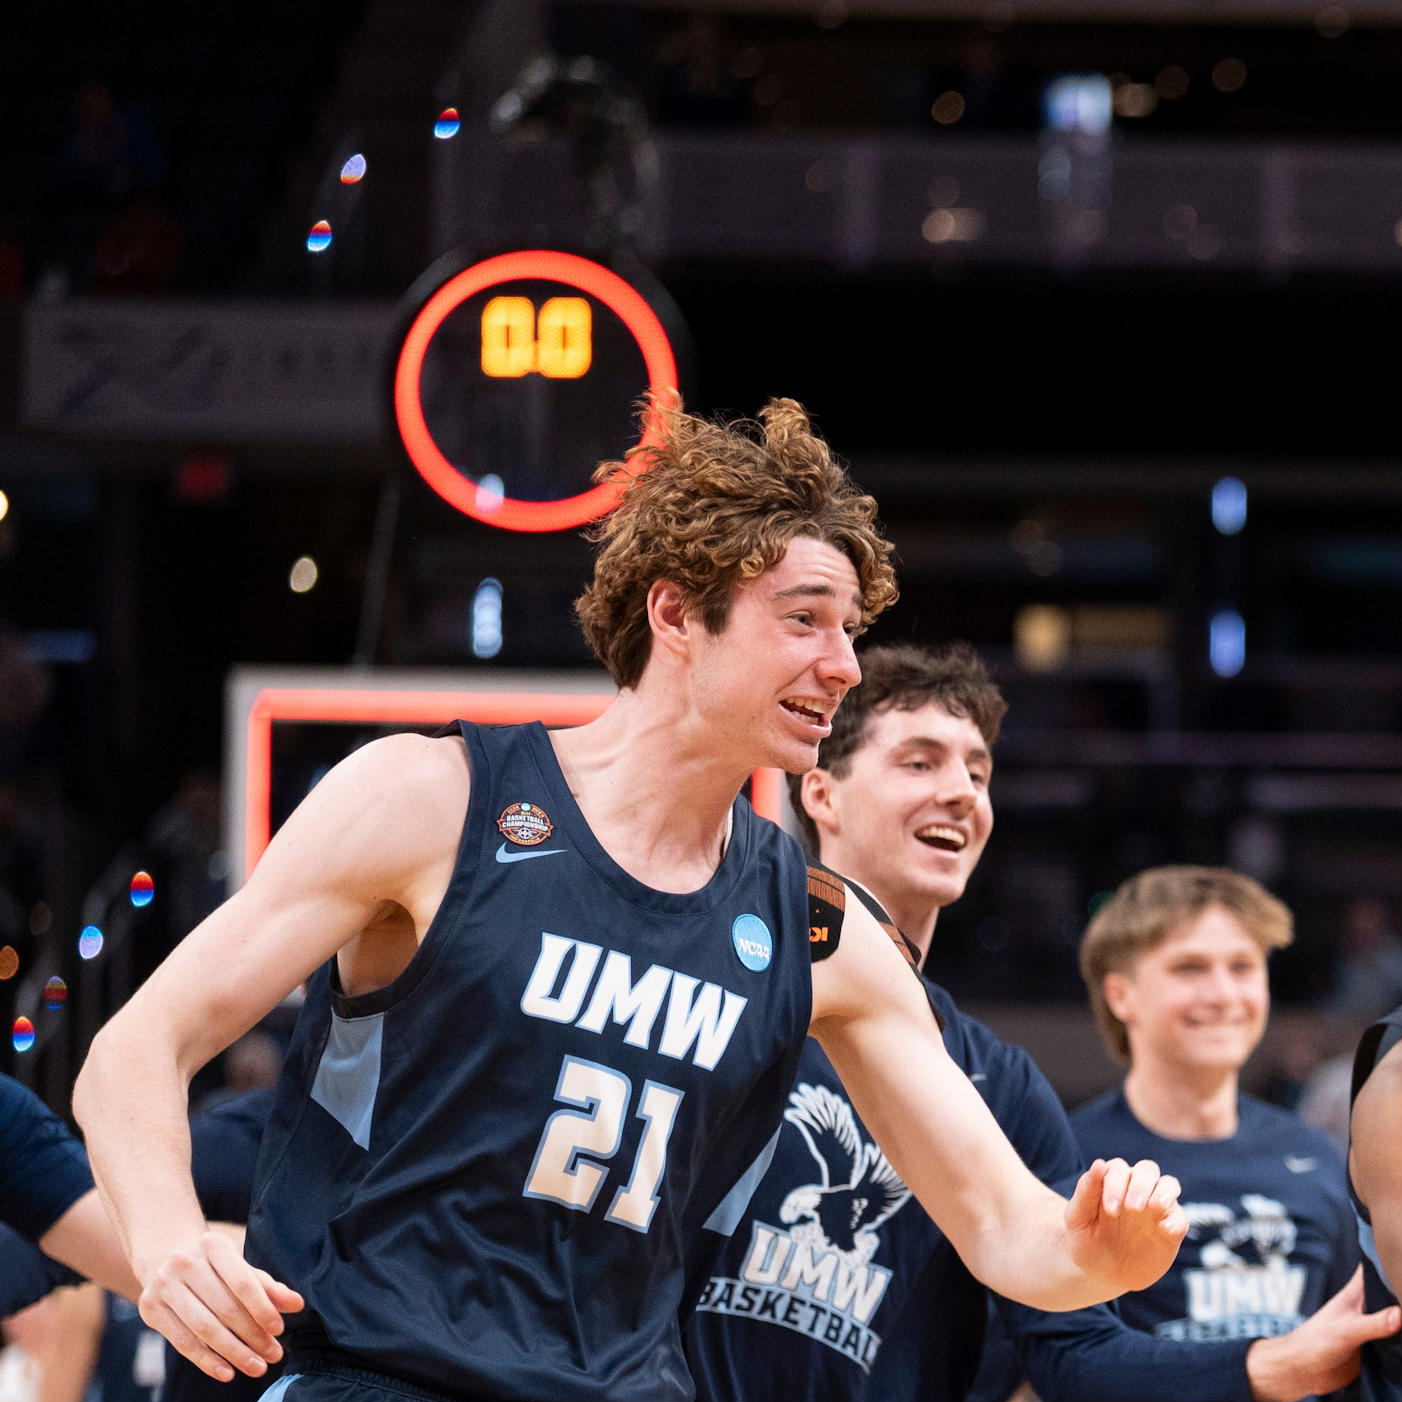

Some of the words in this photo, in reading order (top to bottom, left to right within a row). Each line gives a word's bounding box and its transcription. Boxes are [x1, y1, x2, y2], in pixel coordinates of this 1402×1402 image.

[502, 821, 549, 831] CHAMPIONSHIP
[506, 815, 544, 825] BASKETBALL
[738, 937, 771, 961] NCAA
[520, 932, 748, 1071] UMW
[522, 1054, 686, 1234] 21
[740, 1221, 893, 1326] UMW
[1183, 1266, 1308, 1323] UMW
